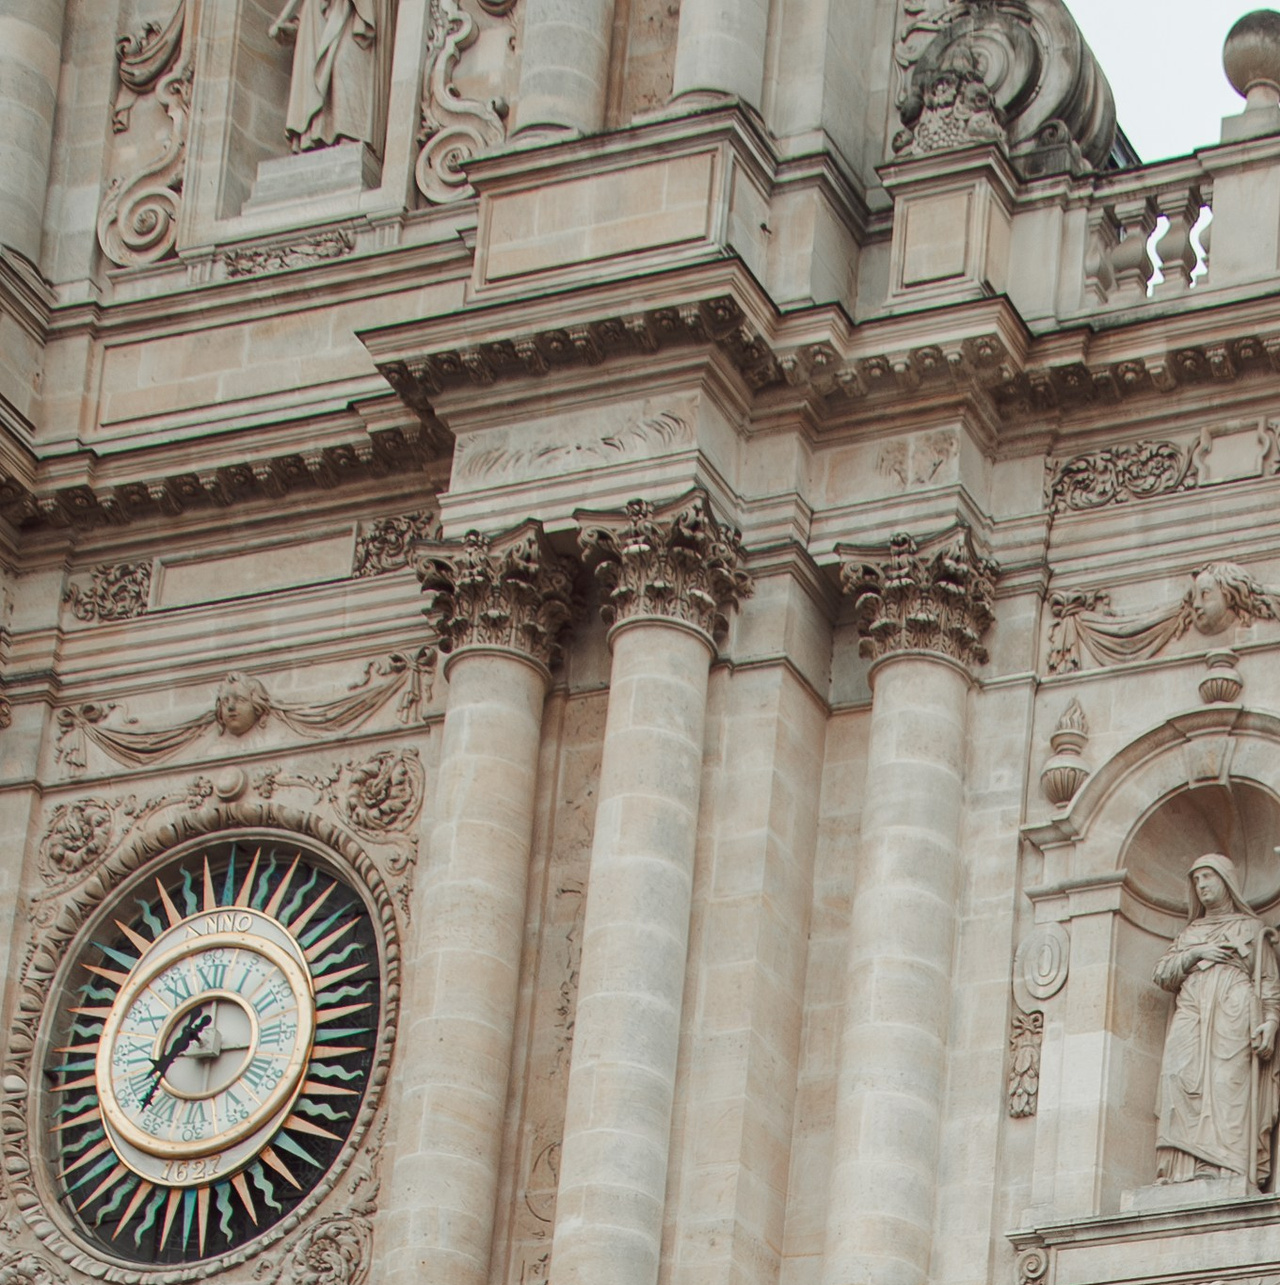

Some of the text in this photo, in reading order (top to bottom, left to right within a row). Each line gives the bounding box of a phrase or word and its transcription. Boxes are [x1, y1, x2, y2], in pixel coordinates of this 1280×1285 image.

[185, 914, 253, 937] ANNO
[250, 954, 262, 967] 5
[197, 964, 228, 992] XII
[235, 967, 251, 993] I
[276, 978, 293, 999] 10
[165, 975, 194, 1010] XI
[253, 989, 281, 1017] II
[137, 1005, 170, 1034] X
[285, 1022, 297, 1041] 15
[260, 1020, 283, 1046] III
[126, 1040, 154, 1067] IX
[264, 1068, 284, 1091] 20
[148, 1093, 178, 1123] VII
[182, 1100, 208, 1125] VI
[218, 1090, 243, 1114] V
[141, 1117, 162, 1136] 35
[226, 1107, 250, 1125] 25
[181, 1124, 205, 1142] 30
[160, 1155, 222, 1182] 1627
